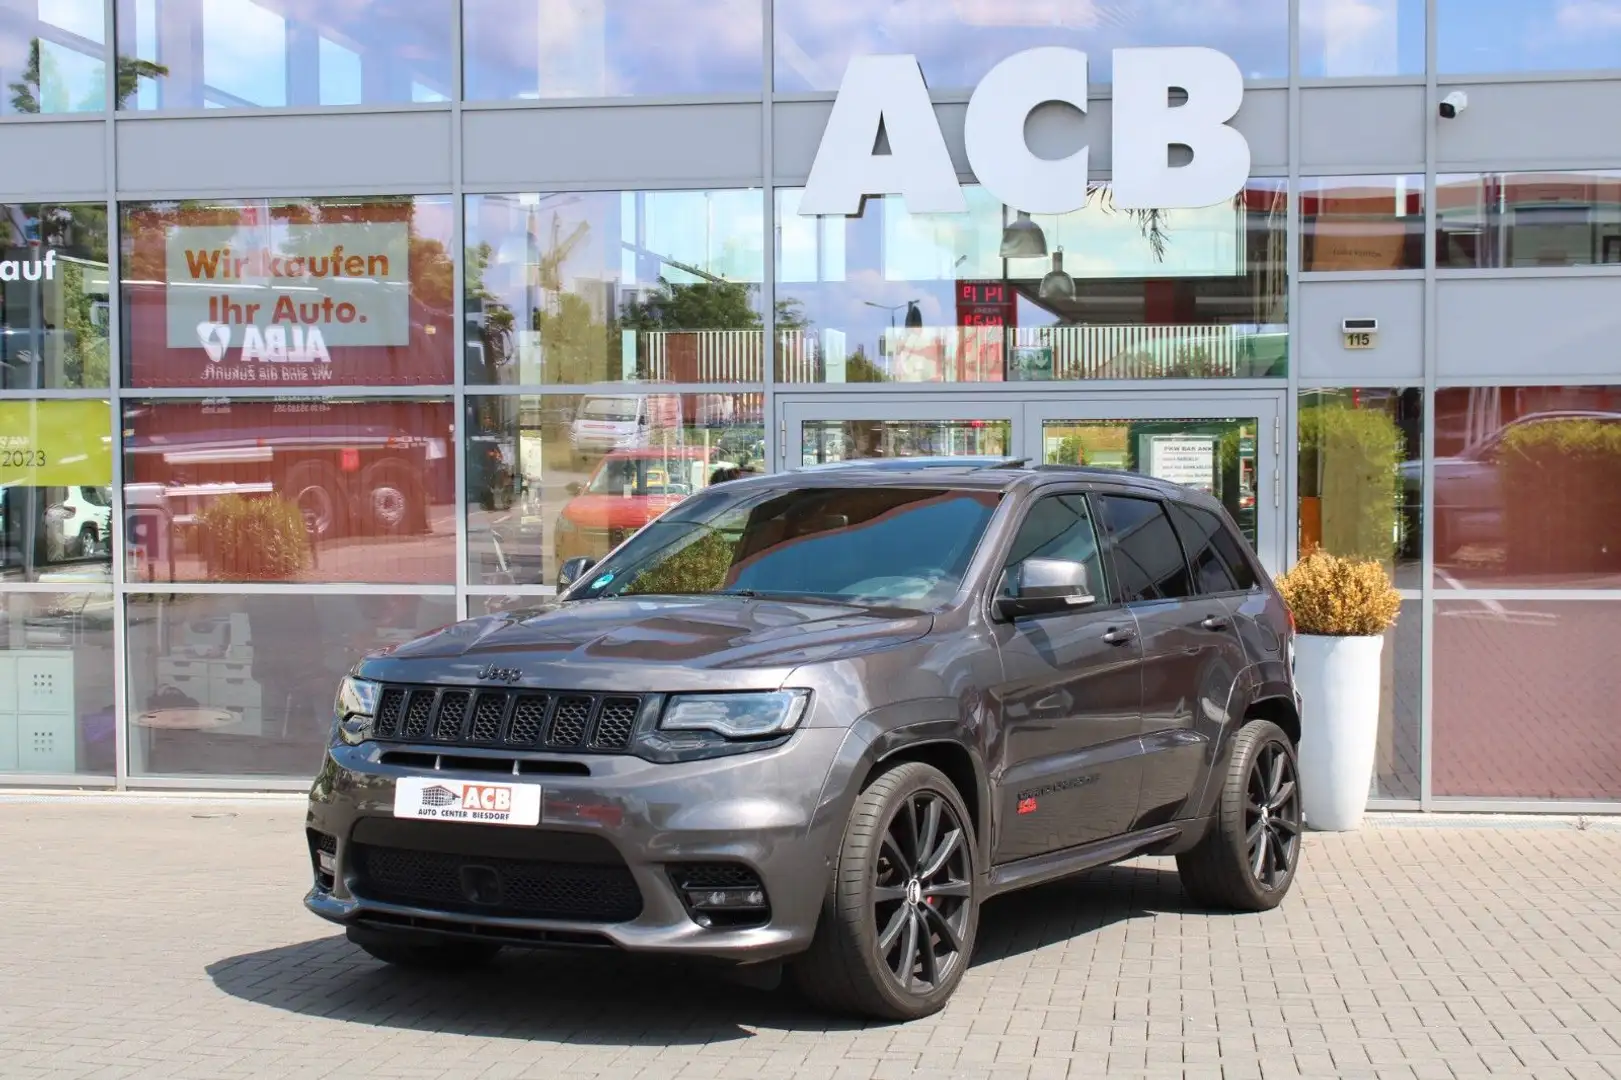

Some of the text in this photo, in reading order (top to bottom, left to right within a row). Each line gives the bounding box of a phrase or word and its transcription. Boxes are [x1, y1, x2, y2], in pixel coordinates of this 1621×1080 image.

[797, 46, 1250, 215] ACB
[0, 249, 56, 281] auf
[185, 245, 389, 279] Wir kaufen
[209, 294, 367, 324] Ihr Auto.
[1347, 333, 1370, 346] 115
[2, 450, 46, 467] 2023
[476, 663, 523, 684] Jeep
[462, 786, 511, 810] ACB
[441, 809, 468, 818] CENTER
[472, 811, 510, 820] BIESDORF
